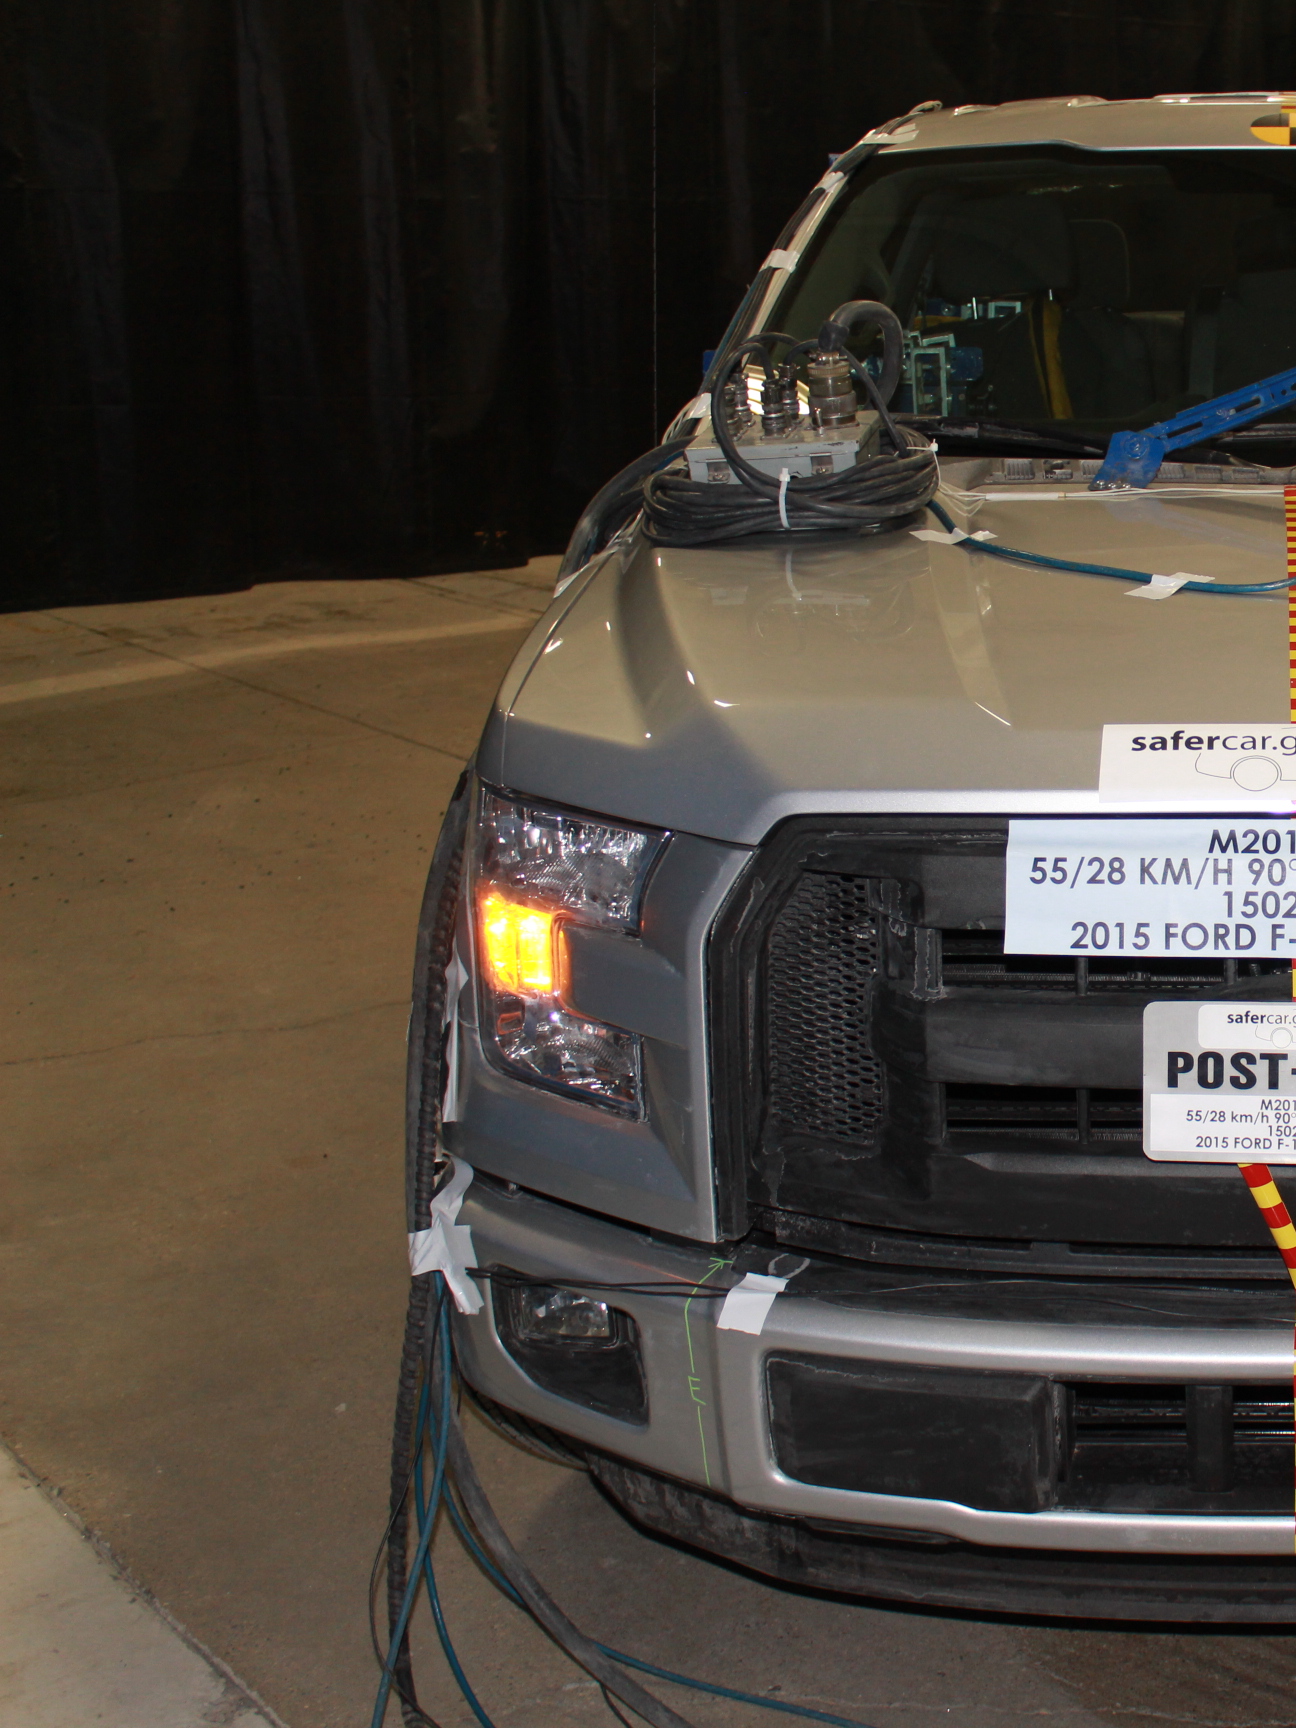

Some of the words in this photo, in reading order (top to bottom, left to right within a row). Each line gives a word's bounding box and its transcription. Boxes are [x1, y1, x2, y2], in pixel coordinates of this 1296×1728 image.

[1029, 856, 1127, 890] 55/28
[1139, 857, 1234, 890] KM/H
[1069, 921, 1151, 950] 2015
[1164, 922, 1257, 951] FORD
[1185, 1110, 1227, 1125] 55/28
[1231, 1110, 1270, 1125] km/h
[1195, 1136, 1229, 1149] 2015
[1234, 1137, 1273, 1150] FORD
